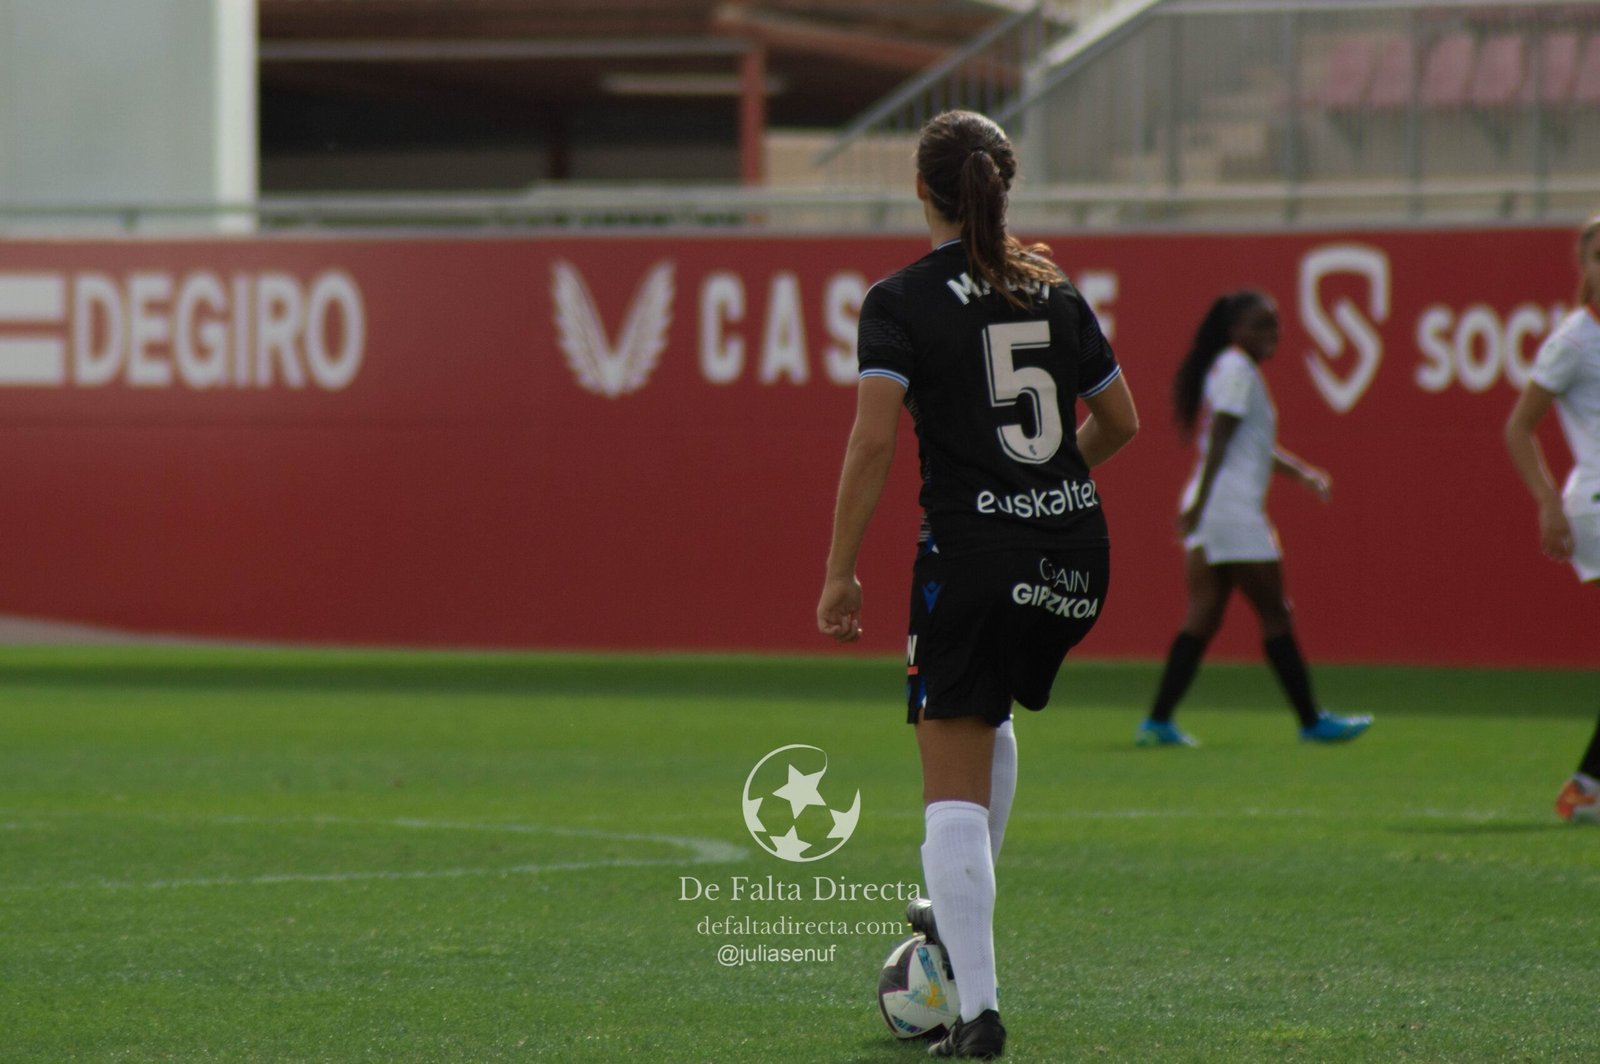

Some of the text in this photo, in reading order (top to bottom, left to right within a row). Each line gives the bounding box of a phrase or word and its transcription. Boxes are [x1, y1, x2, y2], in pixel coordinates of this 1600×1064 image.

[72, 270, 366, 390] DEGIRO
[1414, 303, 1570, 394] SOC
[981, 320, 1063, 465] 5
